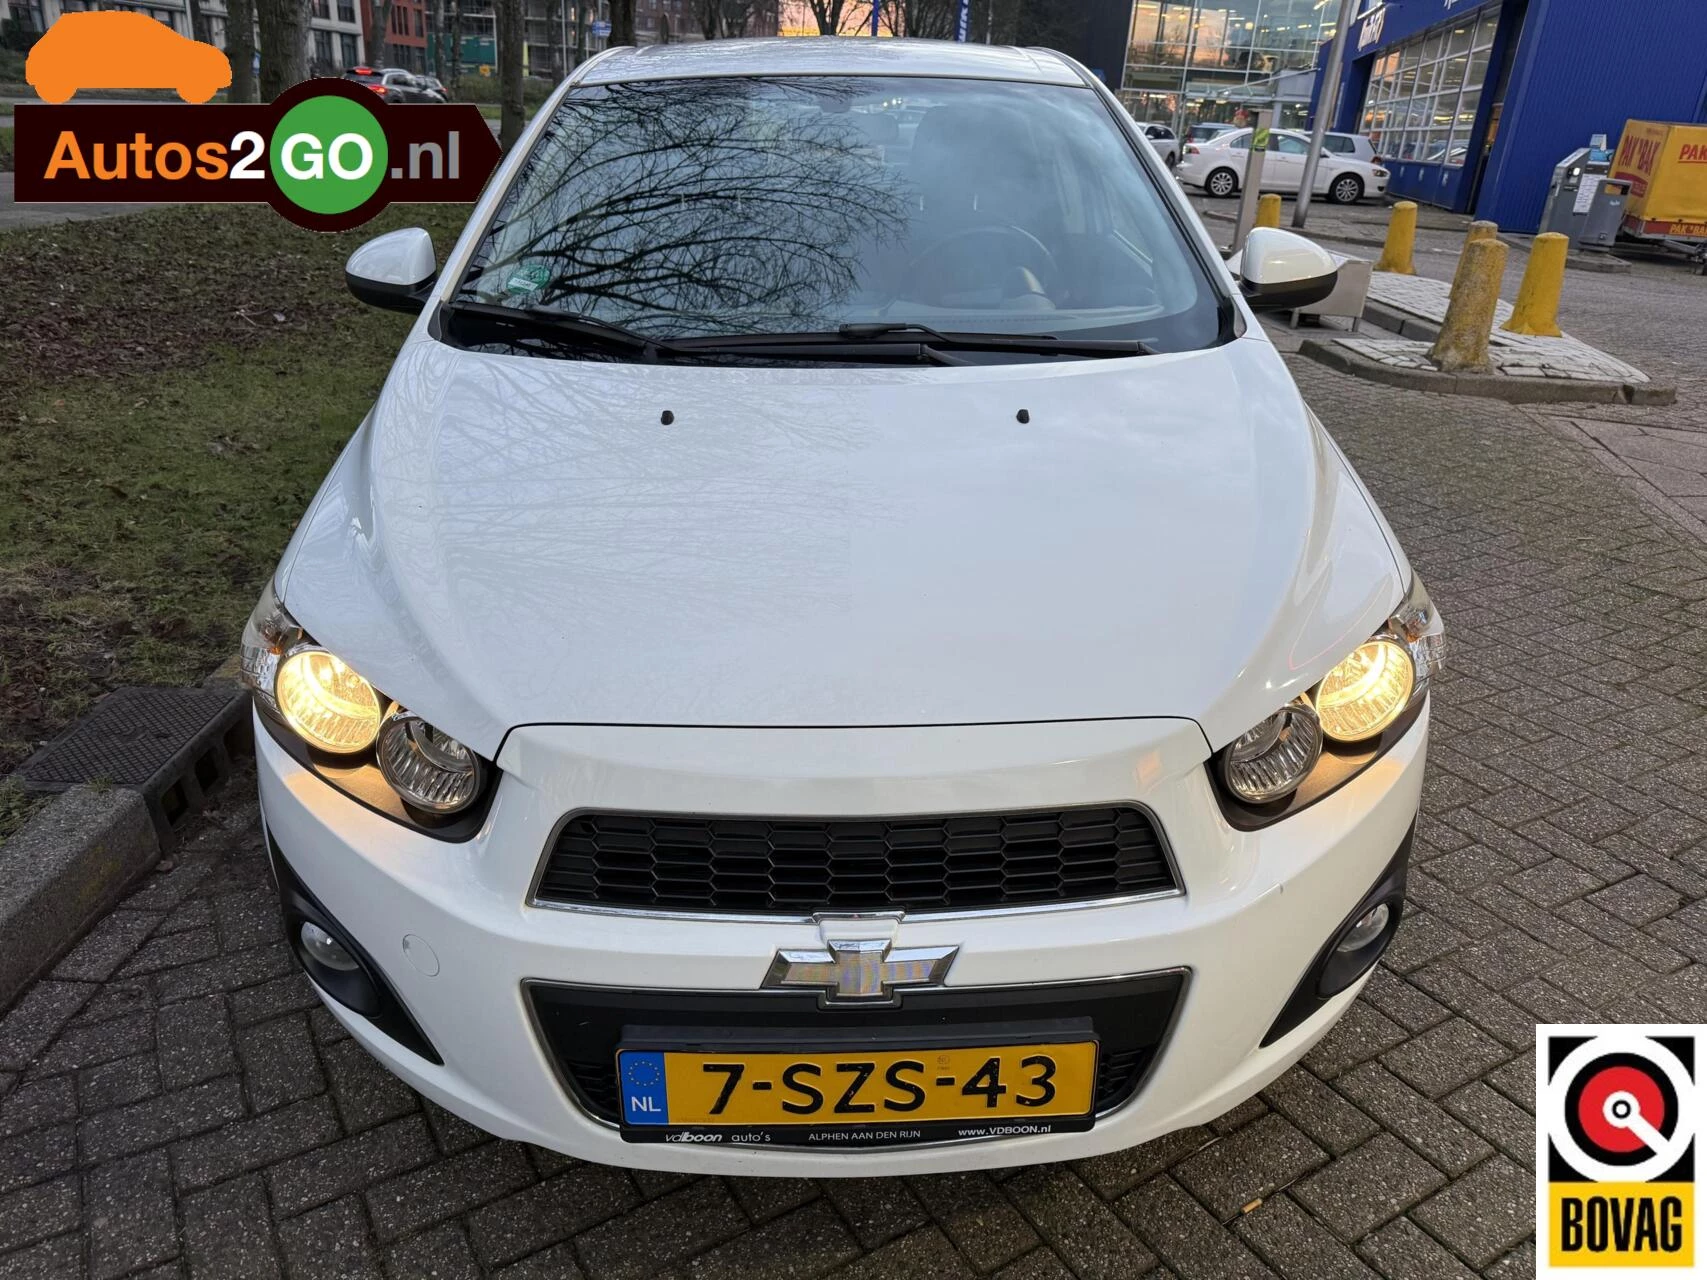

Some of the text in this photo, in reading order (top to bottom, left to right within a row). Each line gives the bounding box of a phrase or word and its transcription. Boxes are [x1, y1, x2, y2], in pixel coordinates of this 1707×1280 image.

[1679, 144, 1707, 161] PAK
[702, 1055, 1057, 1116] 7-SZS-43
[631, 1096, 662, 1112] NL
[731, 1131, 771, 1142] auto's
[808, 1132, 849, 1141] ALPHEN
[851, 1131, 873, 1141] AAN
[876, 1130, 897, 1140] DEN
[899, 1129, 921, 1139] RIJN
[958, 1124, 1051, 1137] www.VDBOON.nl
